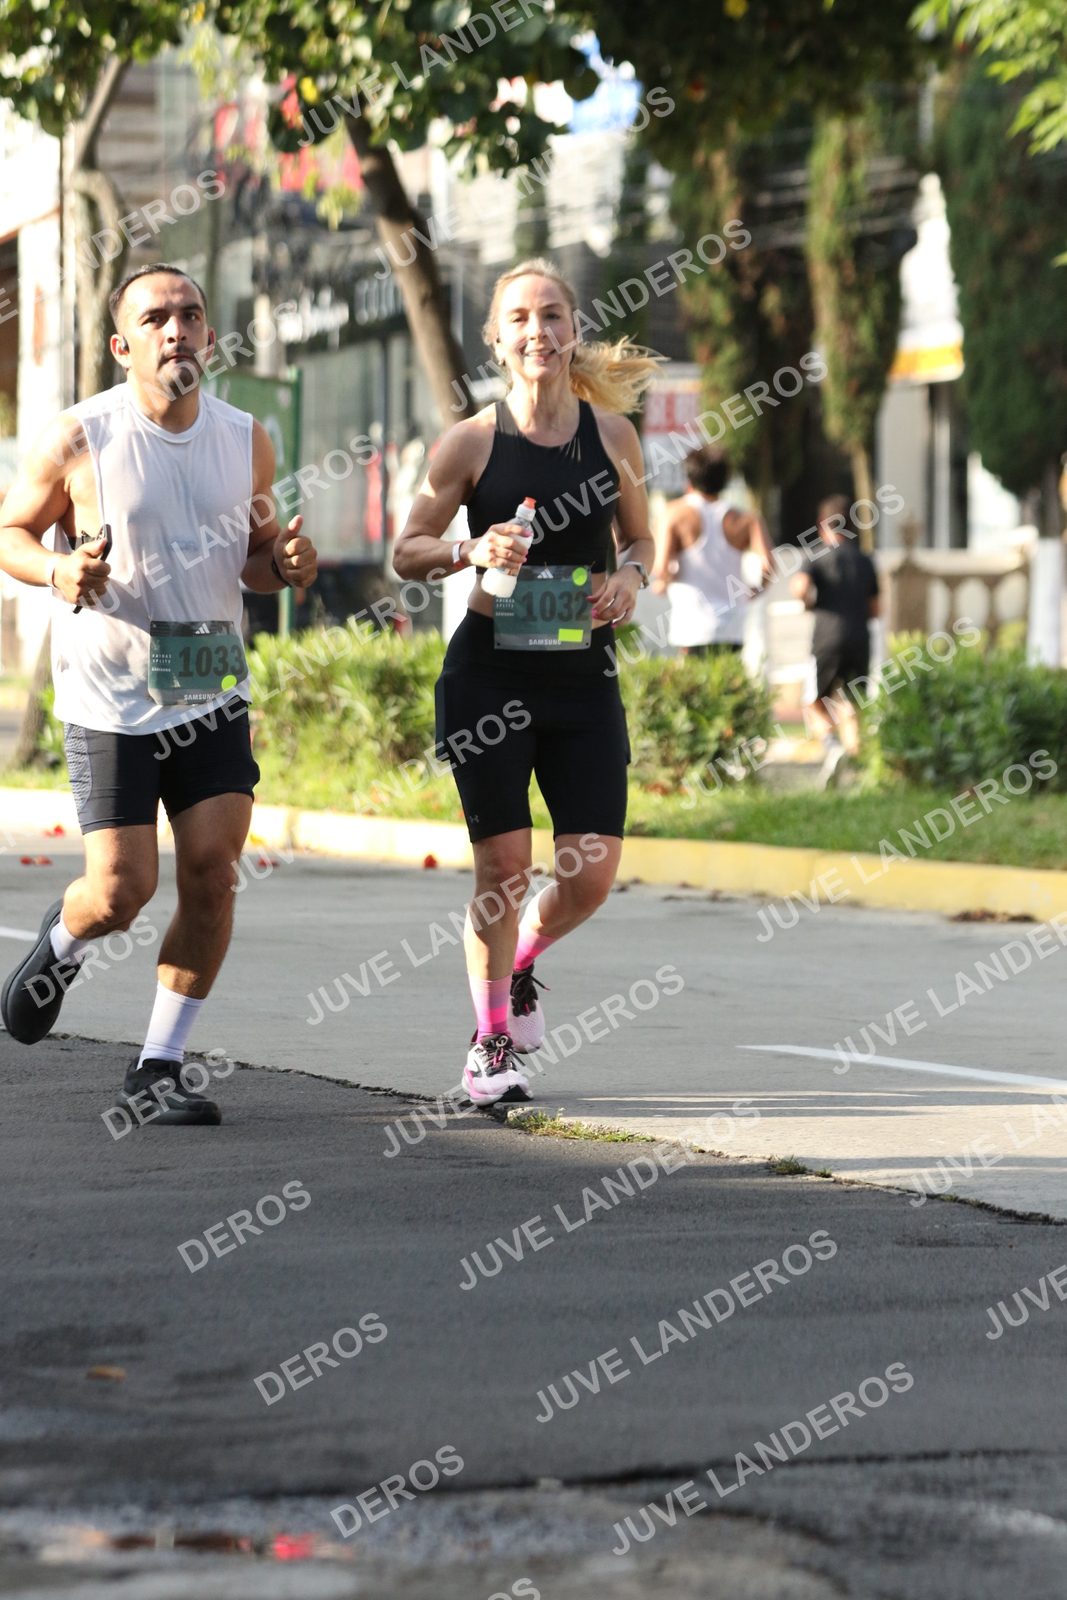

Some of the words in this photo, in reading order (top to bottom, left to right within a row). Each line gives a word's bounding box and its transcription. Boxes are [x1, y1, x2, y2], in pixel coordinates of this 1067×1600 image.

[520, 590, 589, 622] 1032
[528, 638, 561, 646] SAMSUNG
[178, 645, 245, 678] 1033
